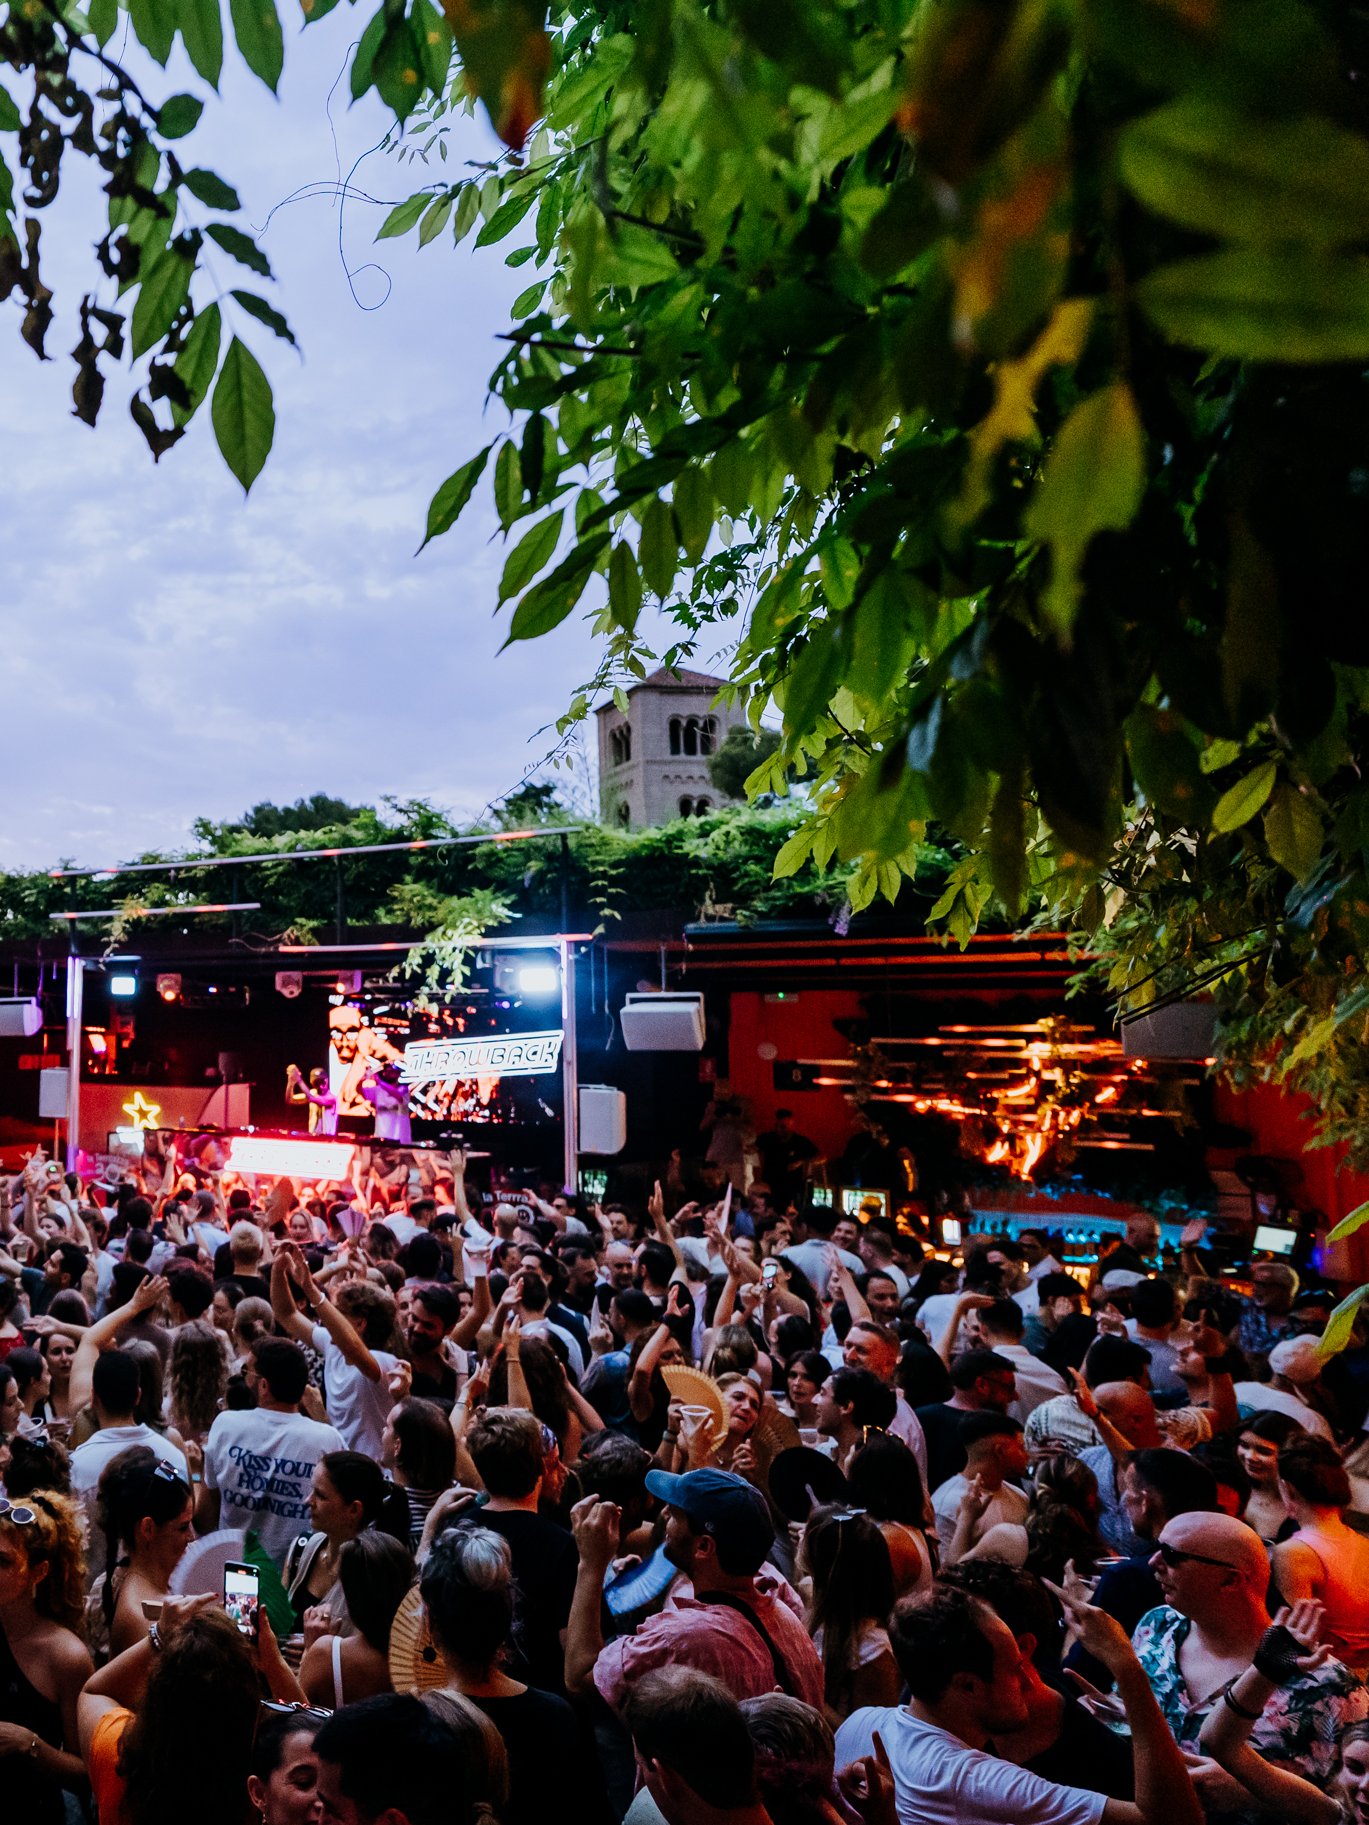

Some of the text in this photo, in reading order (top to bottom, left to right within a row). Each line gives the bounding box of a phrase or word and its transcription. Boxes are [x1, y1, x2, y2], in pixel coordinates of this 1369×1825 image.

[408, 1040, 559, 1072] THROWBACK
[229, 1446, 273, 1475] KISS
[237, 1473, 303, 1499] HOMIES,
[224, 1489, 311, 1519] GOODNIGH
